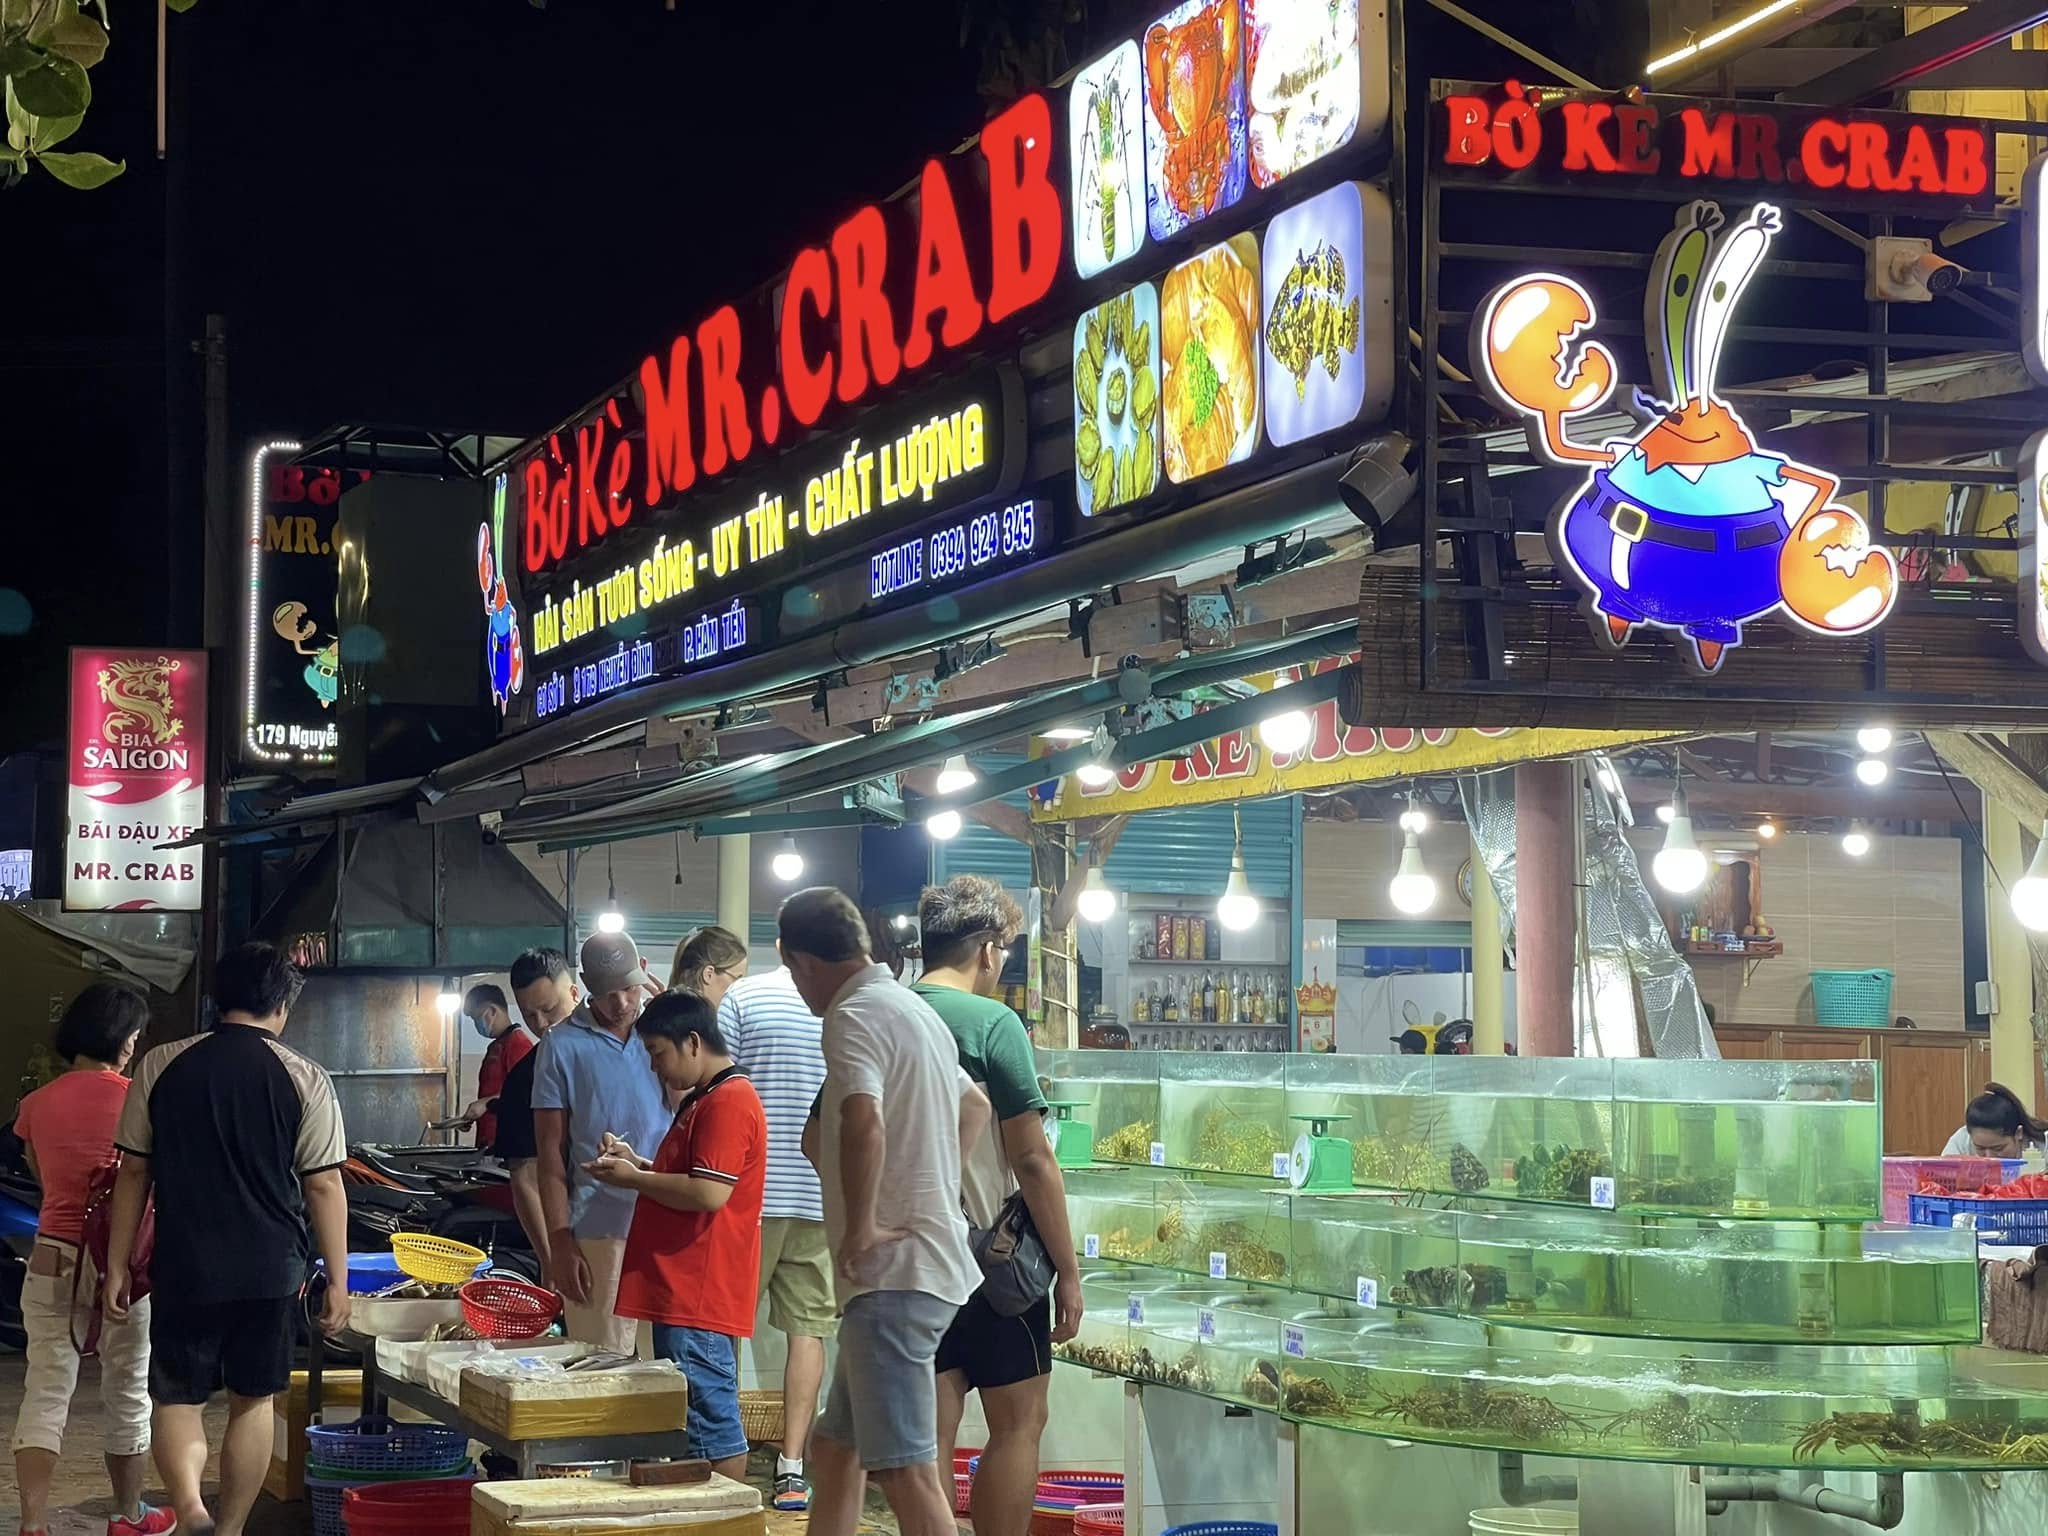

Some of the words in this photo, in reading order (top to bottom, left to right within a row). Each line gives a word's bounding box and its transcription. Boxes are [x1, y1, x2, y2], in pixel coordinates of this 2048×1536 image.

[525, 434, 572, 573] Bờ
[578, 398, 632, 547] Kè
[533, 593, 560, 656] HẢI
[562, 579, 595, 643] SẢN
[596, 564, 636, 627] TƯƠI
[639, 534, 694, 609] SỐNG
[711, 515, 742, 578] UY
[745, 491, 785, 563] TÍN
[805, 438, 874, 537] CHẤT
[880, 403, 984, 507] LƯỢNG
[871, 538, 923, 599] HOTLINE
[930, 525, 967, 580] 0394
[970, 512, 999, 566] 924
[1003, 500, 1034, 556] 345
[121, 733, 153, 747] BIA
[256, 723, 286, 745] 179
[83, 747, 189, 770] SAIGON
[78, 820, 111, 839] BÃI
[118, 820, 159, 845] ĐẬU
[74, 862, 119, 881] MR.
[125, 862, 195, 881] CRAB
